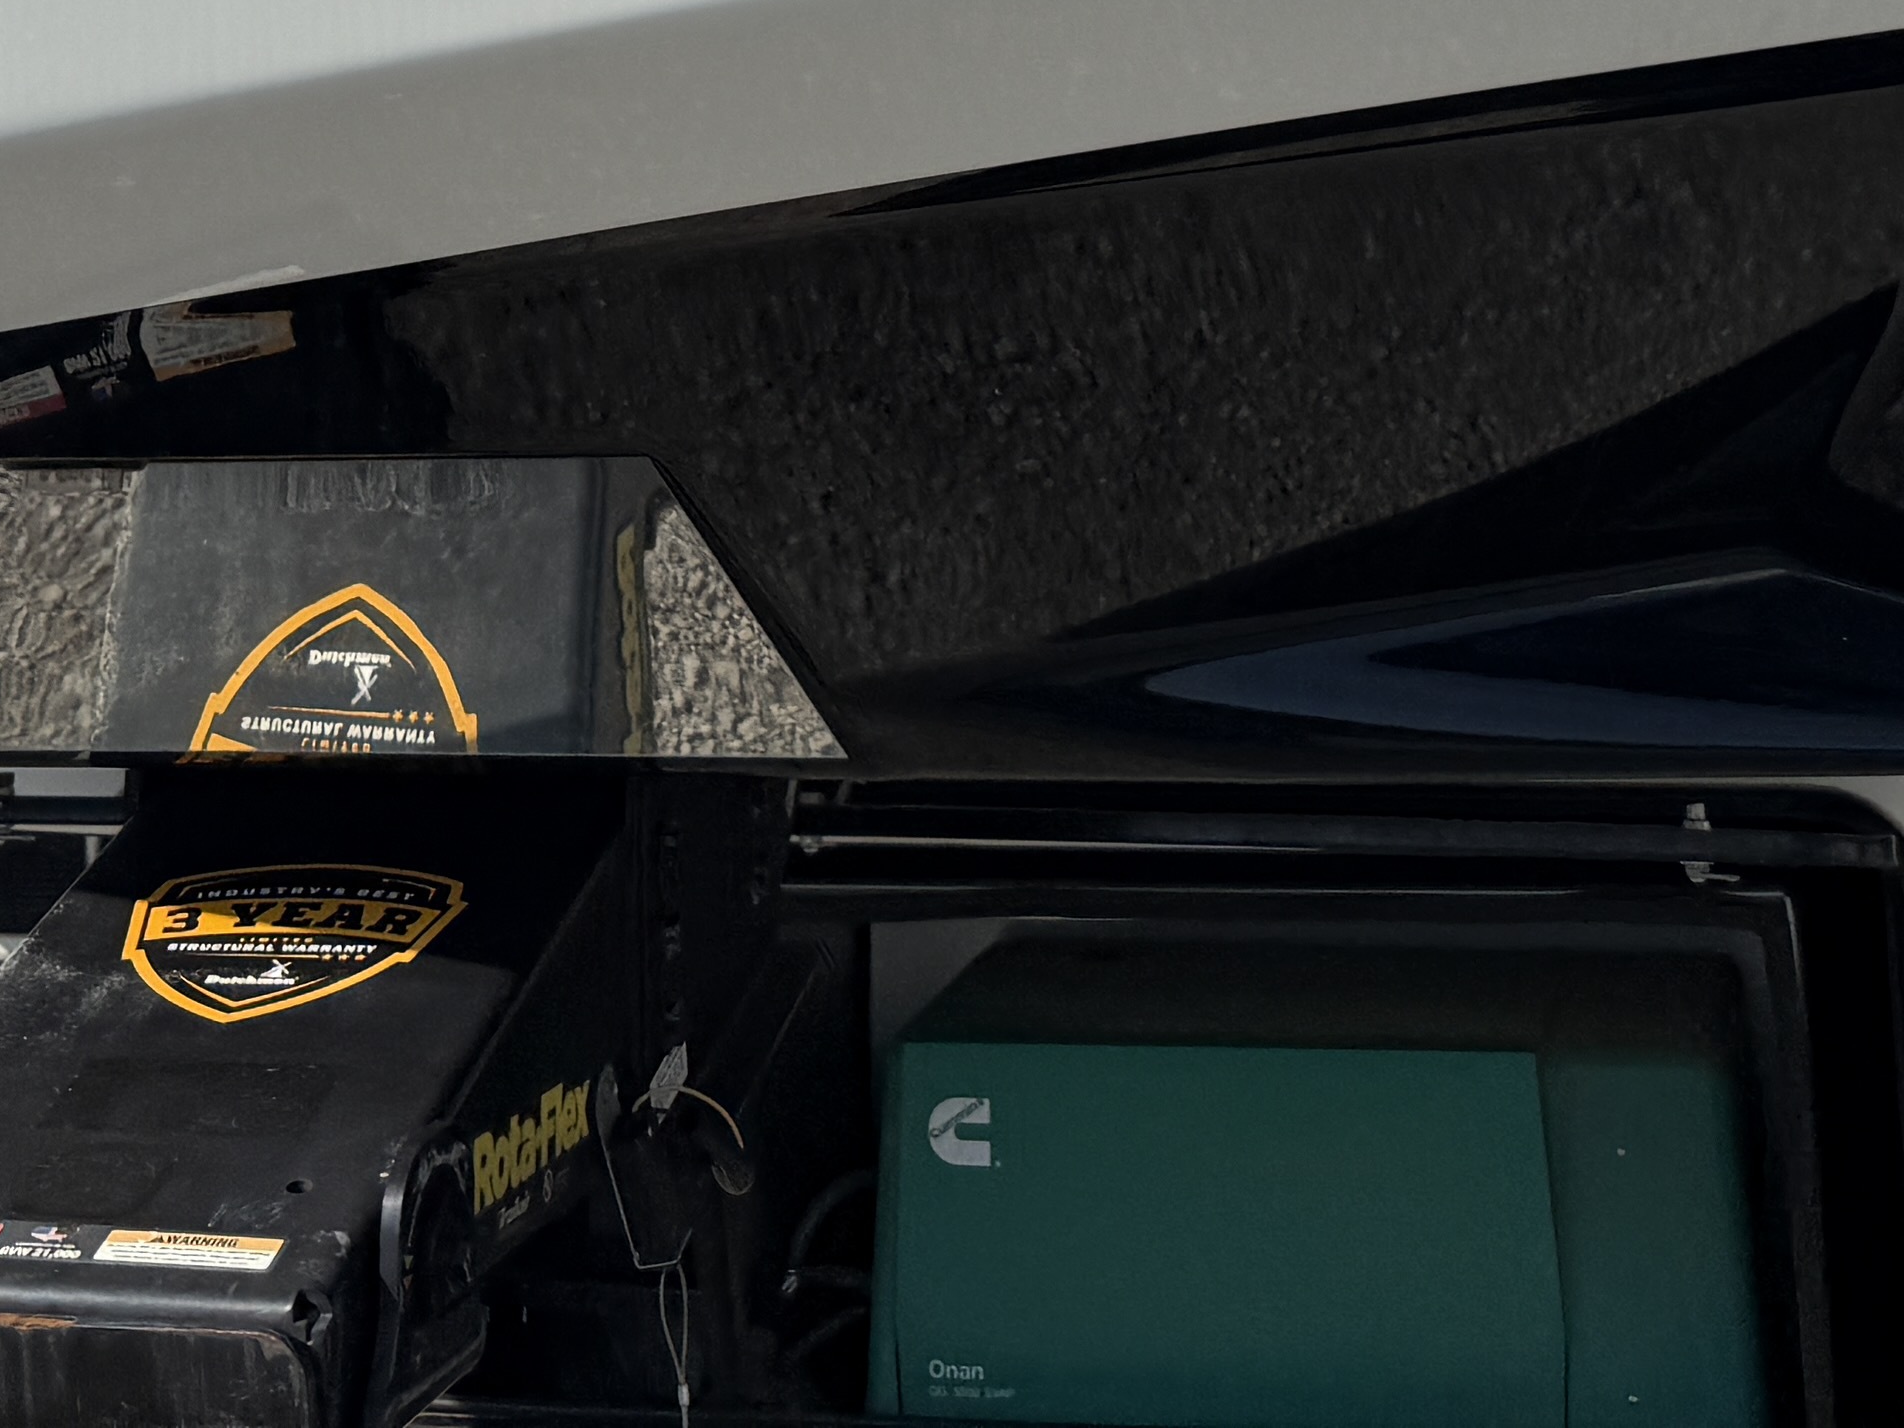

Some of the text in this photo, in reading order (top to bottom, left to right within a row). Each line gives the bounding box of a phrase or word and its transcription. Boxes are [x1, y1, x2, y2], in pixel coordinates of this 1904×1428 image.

[162, 900, 422, 936] 3 YEAR
[281, 943, 378, 954] WARRANTY
[166, 1234, 241, 1249] WARNING
[928, 1359, 985, 1380] Onan
